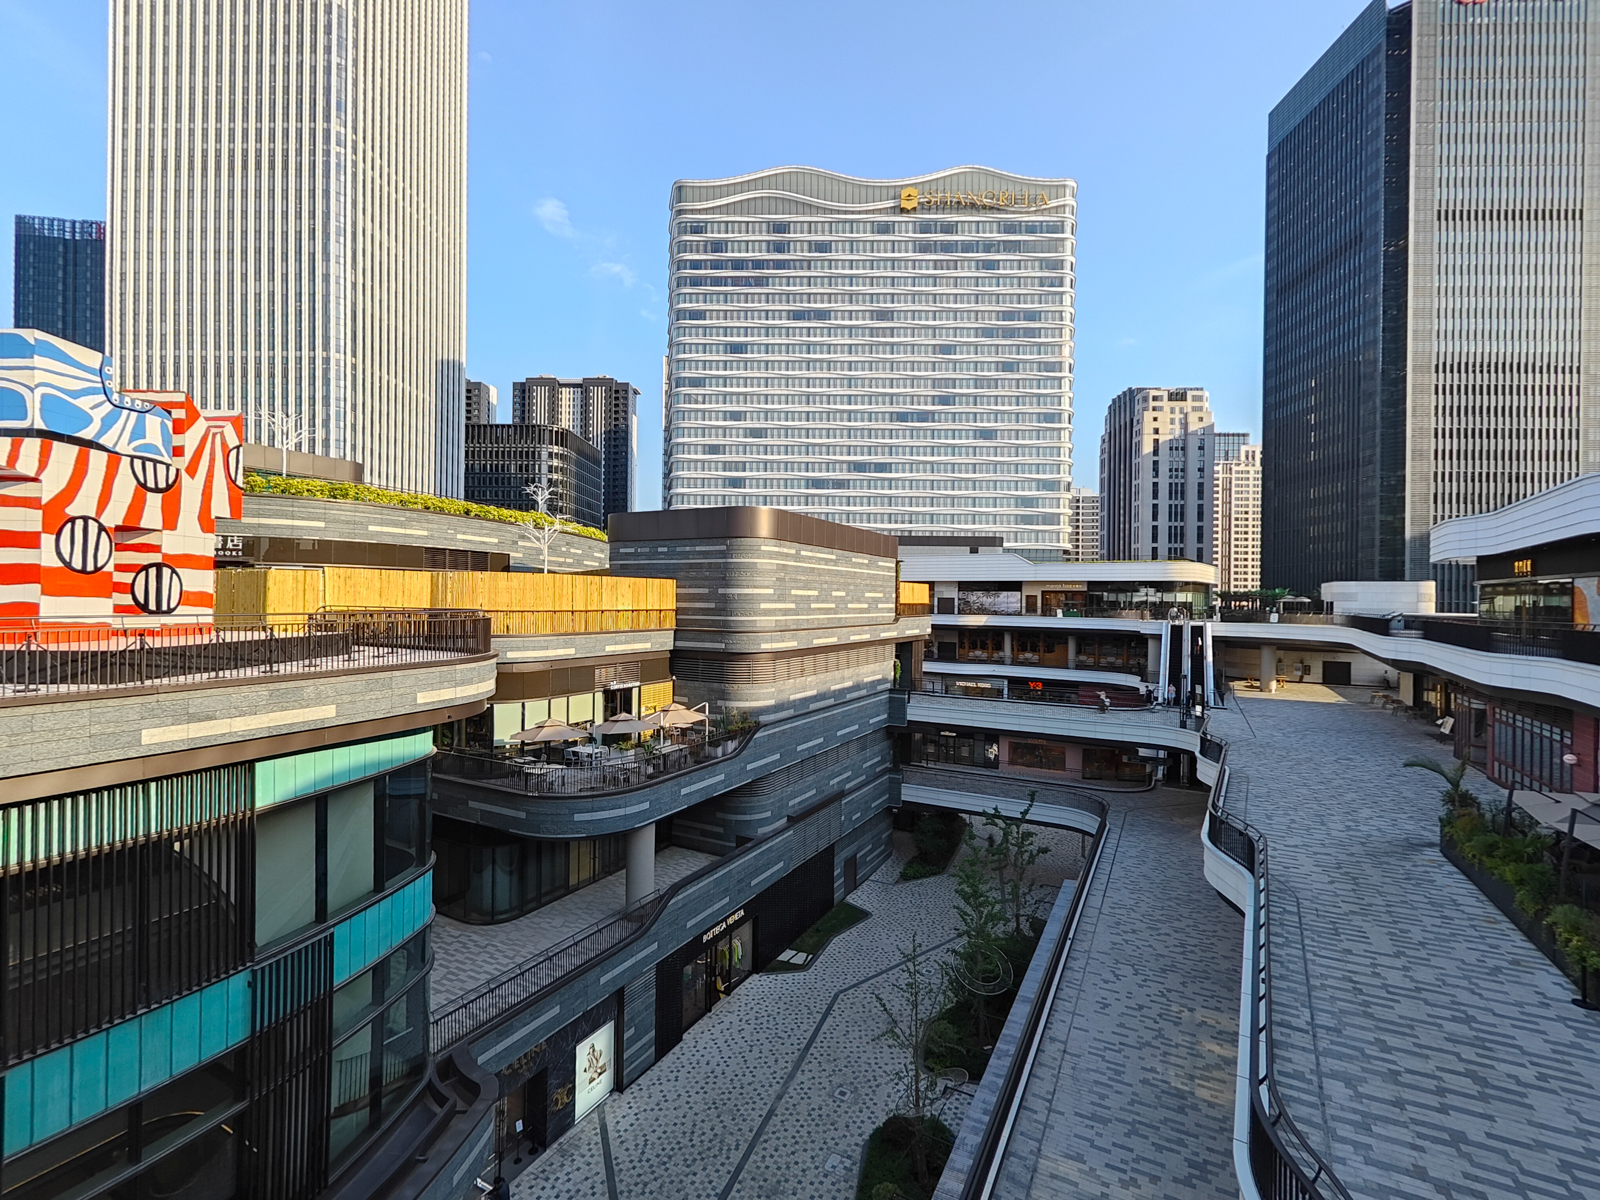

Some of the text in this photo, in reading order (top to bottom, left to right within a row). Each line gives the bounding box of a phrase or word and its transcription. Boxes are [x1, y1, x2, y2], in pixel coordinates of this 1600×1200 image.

[924, 189, 1050, 207] SHANGRI-LA
[703, 908, 745, 943] BOTTEGA VENETA
[587, 1079, 603, 1094] CELINE
